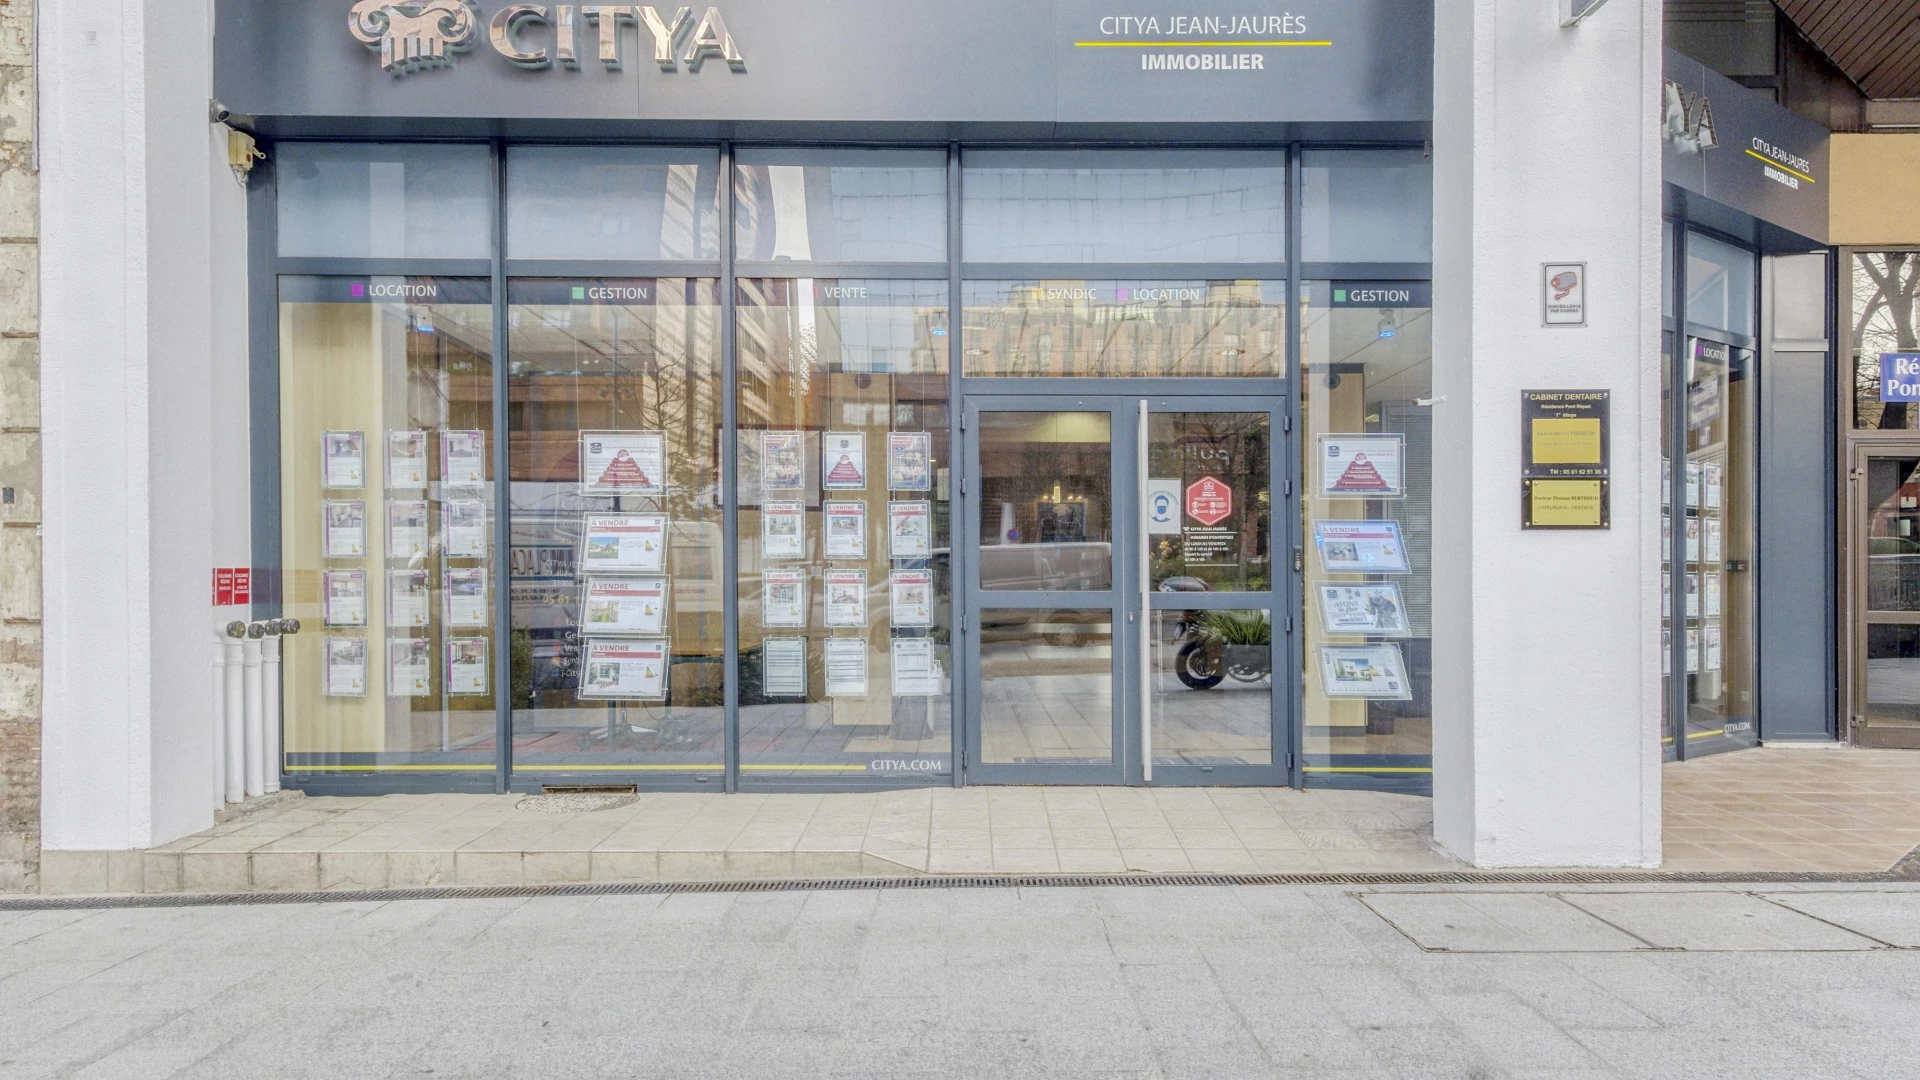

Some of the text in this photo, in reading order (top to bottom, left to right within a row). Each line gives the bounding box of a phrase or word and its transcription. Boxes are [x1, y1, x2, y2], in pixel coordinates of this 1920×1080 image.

[1100, 12, 1307, 35] CITYA JEAN-JAURÈS
[489, 4, 745, 65] CITYA
[1141, 53, 1264, 70] IMMOBILIER
[1752, 137, 1771, 156] CITYA
[1764, 165, 1799, 190] IMMOBILIER
[368, 283, 437, 298] LOCATION
[588, 285, 647, 299] GESTION
[824, 286, 867, 299] VENTE
[1048, 287, 1097, 301] SYNDIC
[1133, 288, 1200, 301] LOCATION
[1351, 289, 1409, 302] GESTION
[1703, 347, 1728, 362] LOCATION
[1724, 721, 1750, 733] CITYA.COM
[871, 759, 942, 771] CITYA.COM
